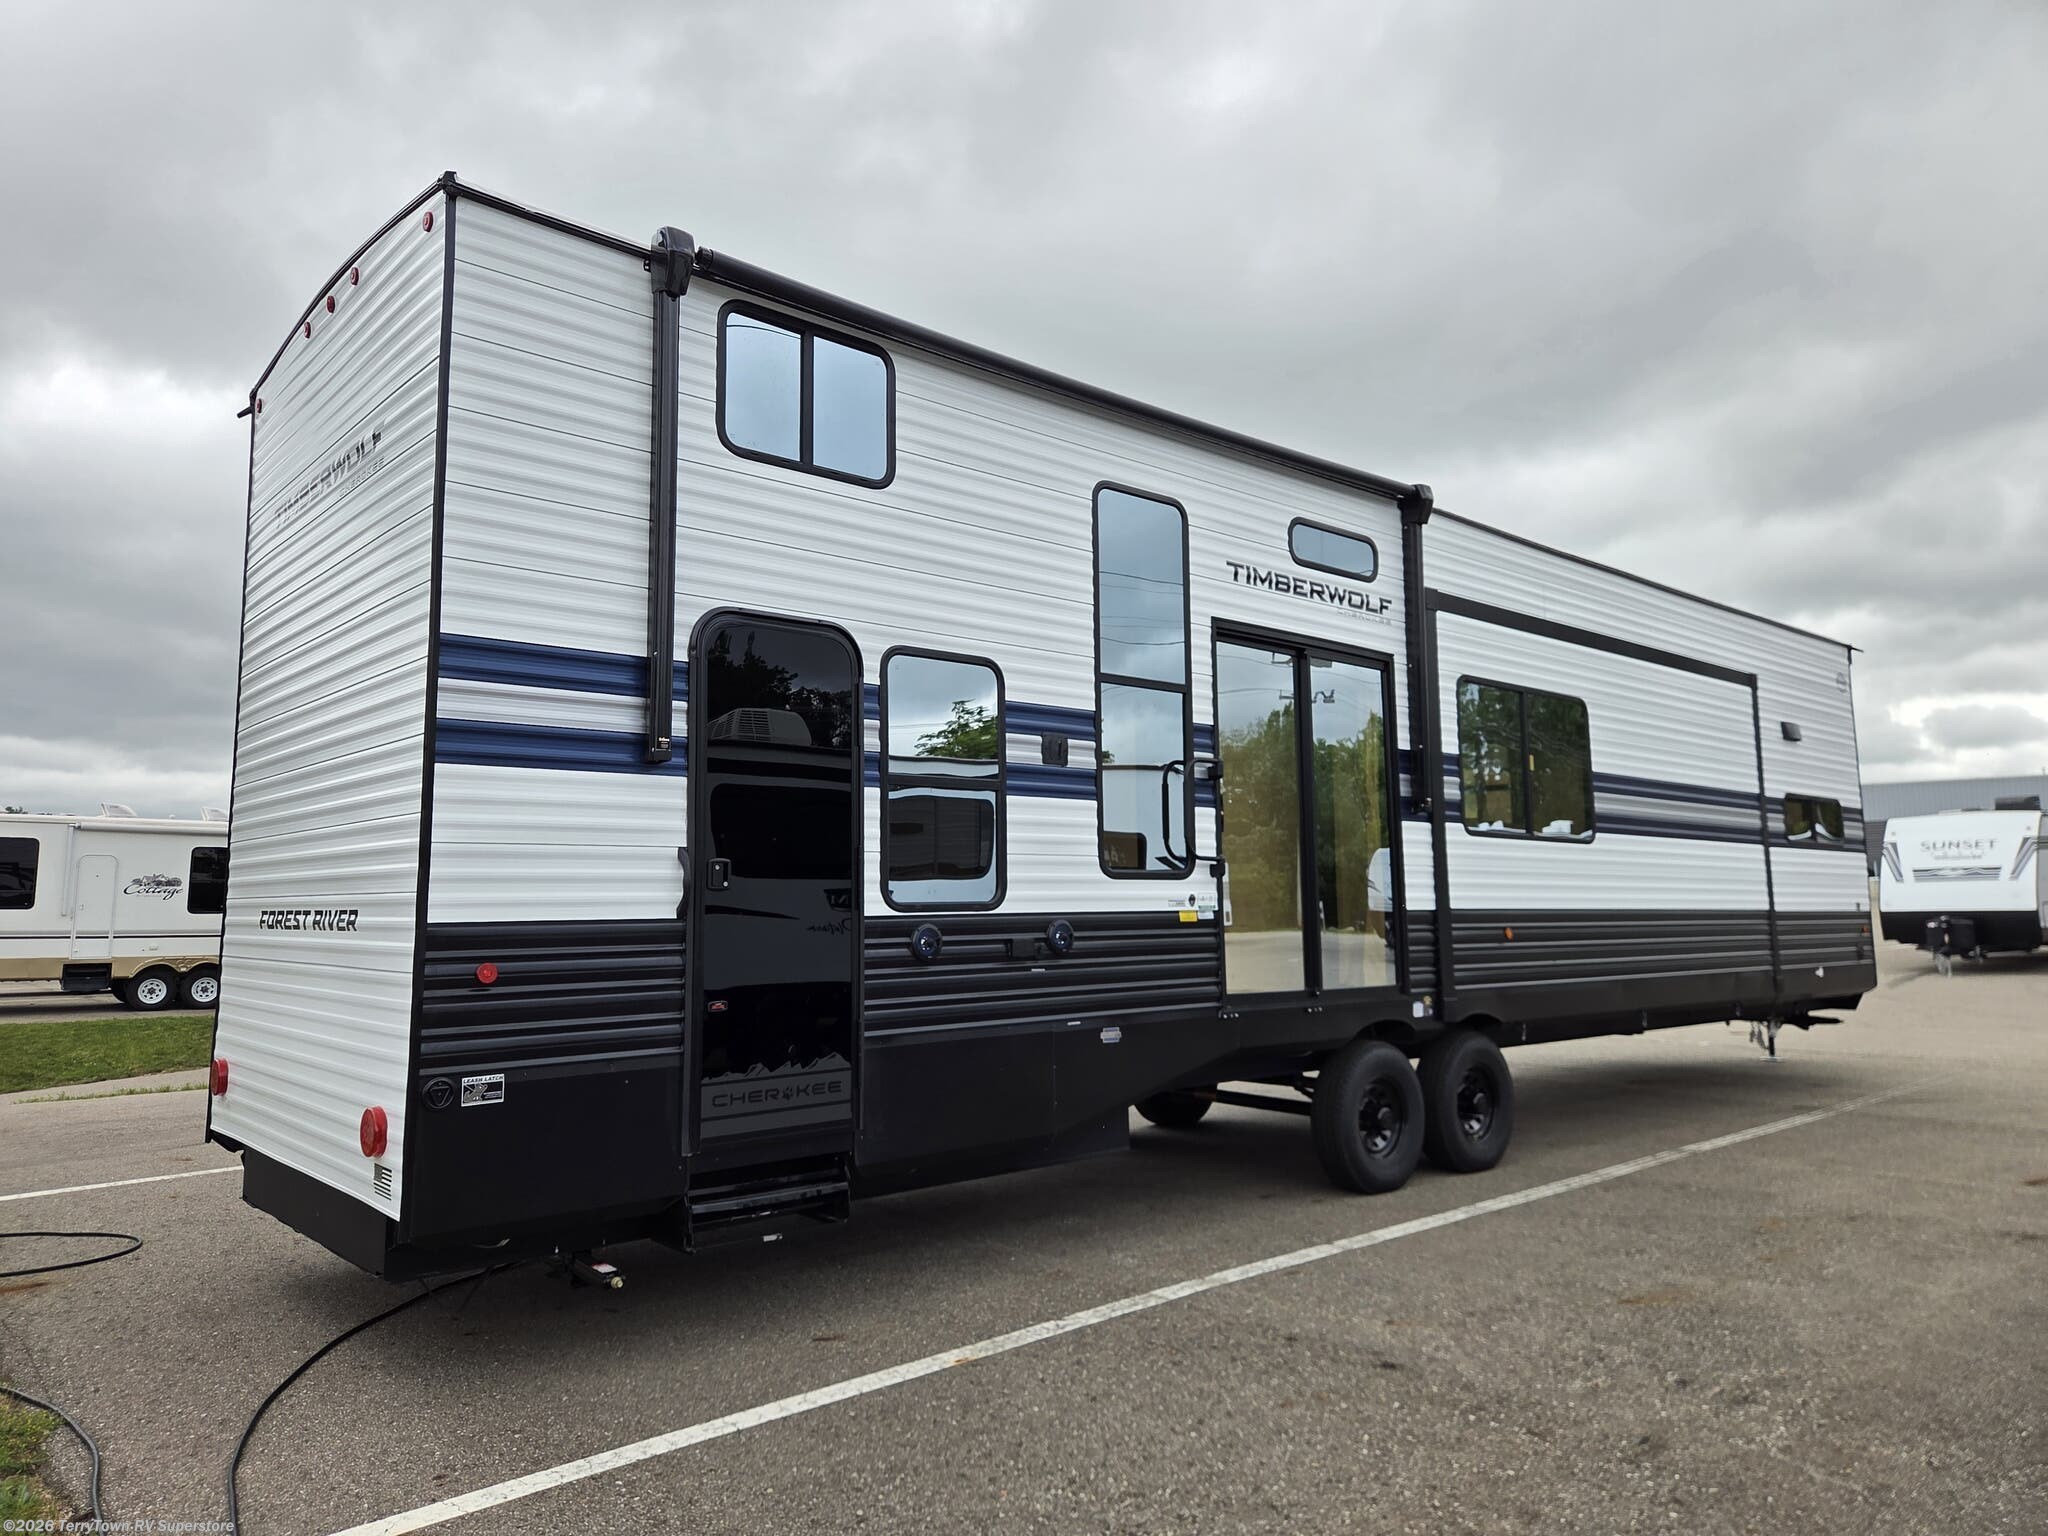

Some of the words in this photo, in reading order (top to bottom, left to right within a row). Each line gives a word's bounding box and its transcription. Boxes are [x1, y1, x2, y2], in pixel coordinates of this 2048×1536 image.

[1226, 560, 1393, 616] TIMBERWOLF
[1920, 838, 1998, 852] SUNSET
[123, 883, 184, 901] Cottage
[260, 910, 311, 931] FOREST
[312, 909, 359, 932] RIVER
